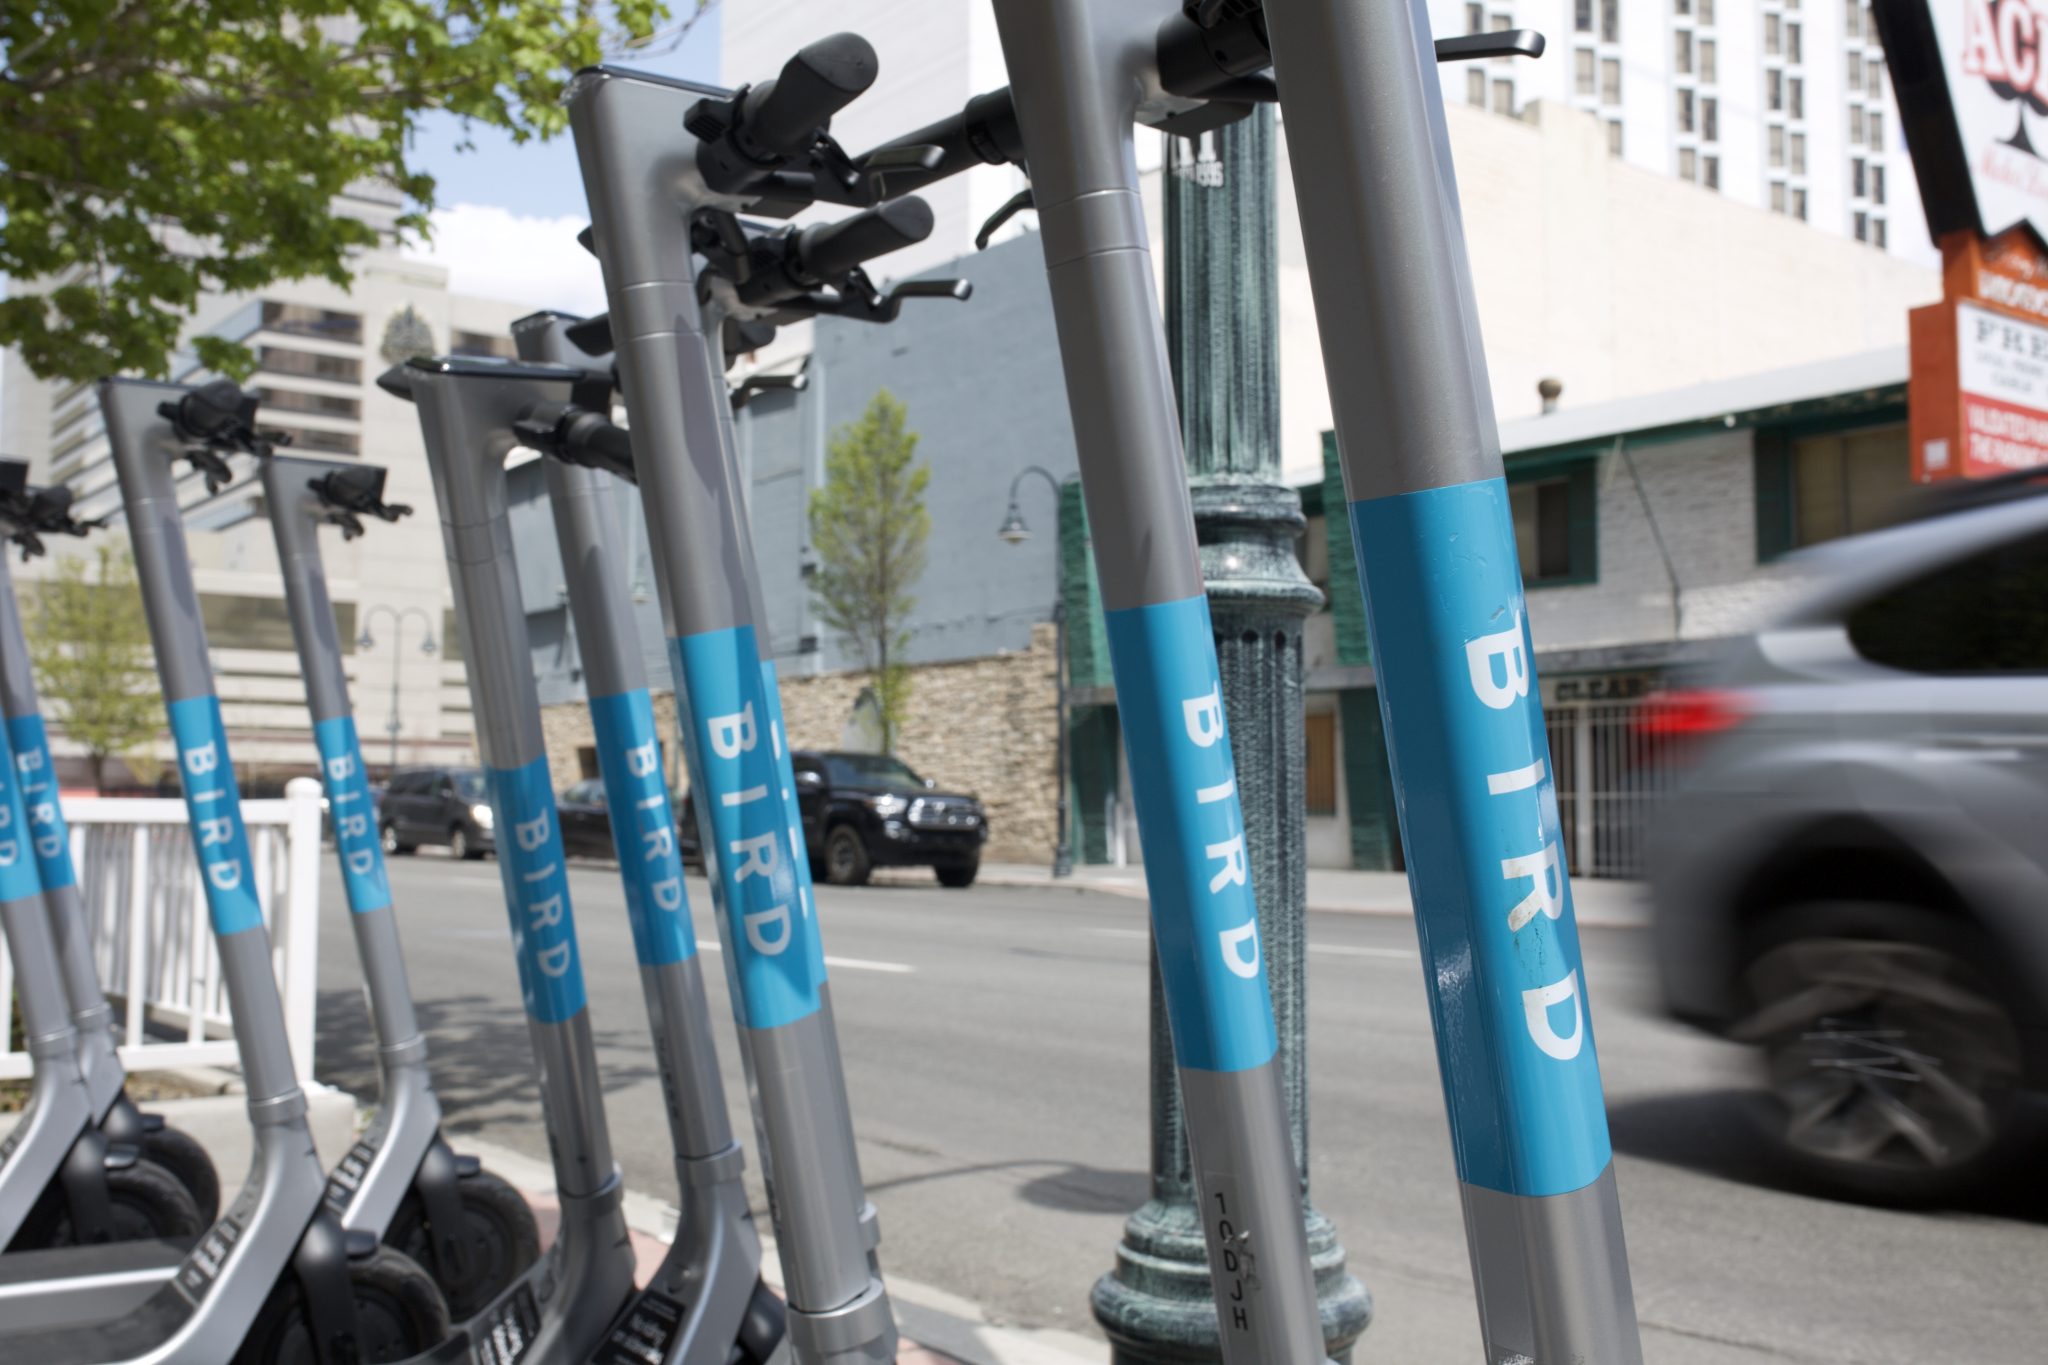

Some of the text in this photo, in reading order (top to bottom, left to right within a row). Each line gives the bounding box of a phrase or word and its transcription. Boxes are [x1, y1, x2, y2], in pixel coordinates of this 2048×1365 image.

[17, 746, 61, 858] BIRD
[184, 740, 242, 890] BIRD
[327, 754, 374, 875] BIRD
[625, 738, 682, 911] BIRD
[708, 701, 791, 956] BIRD
[1182, 680, 1260, 979] BIRD
[1465, 610, 1583, 1060] BIRD
[515, 808, 571, 977] BIRD
